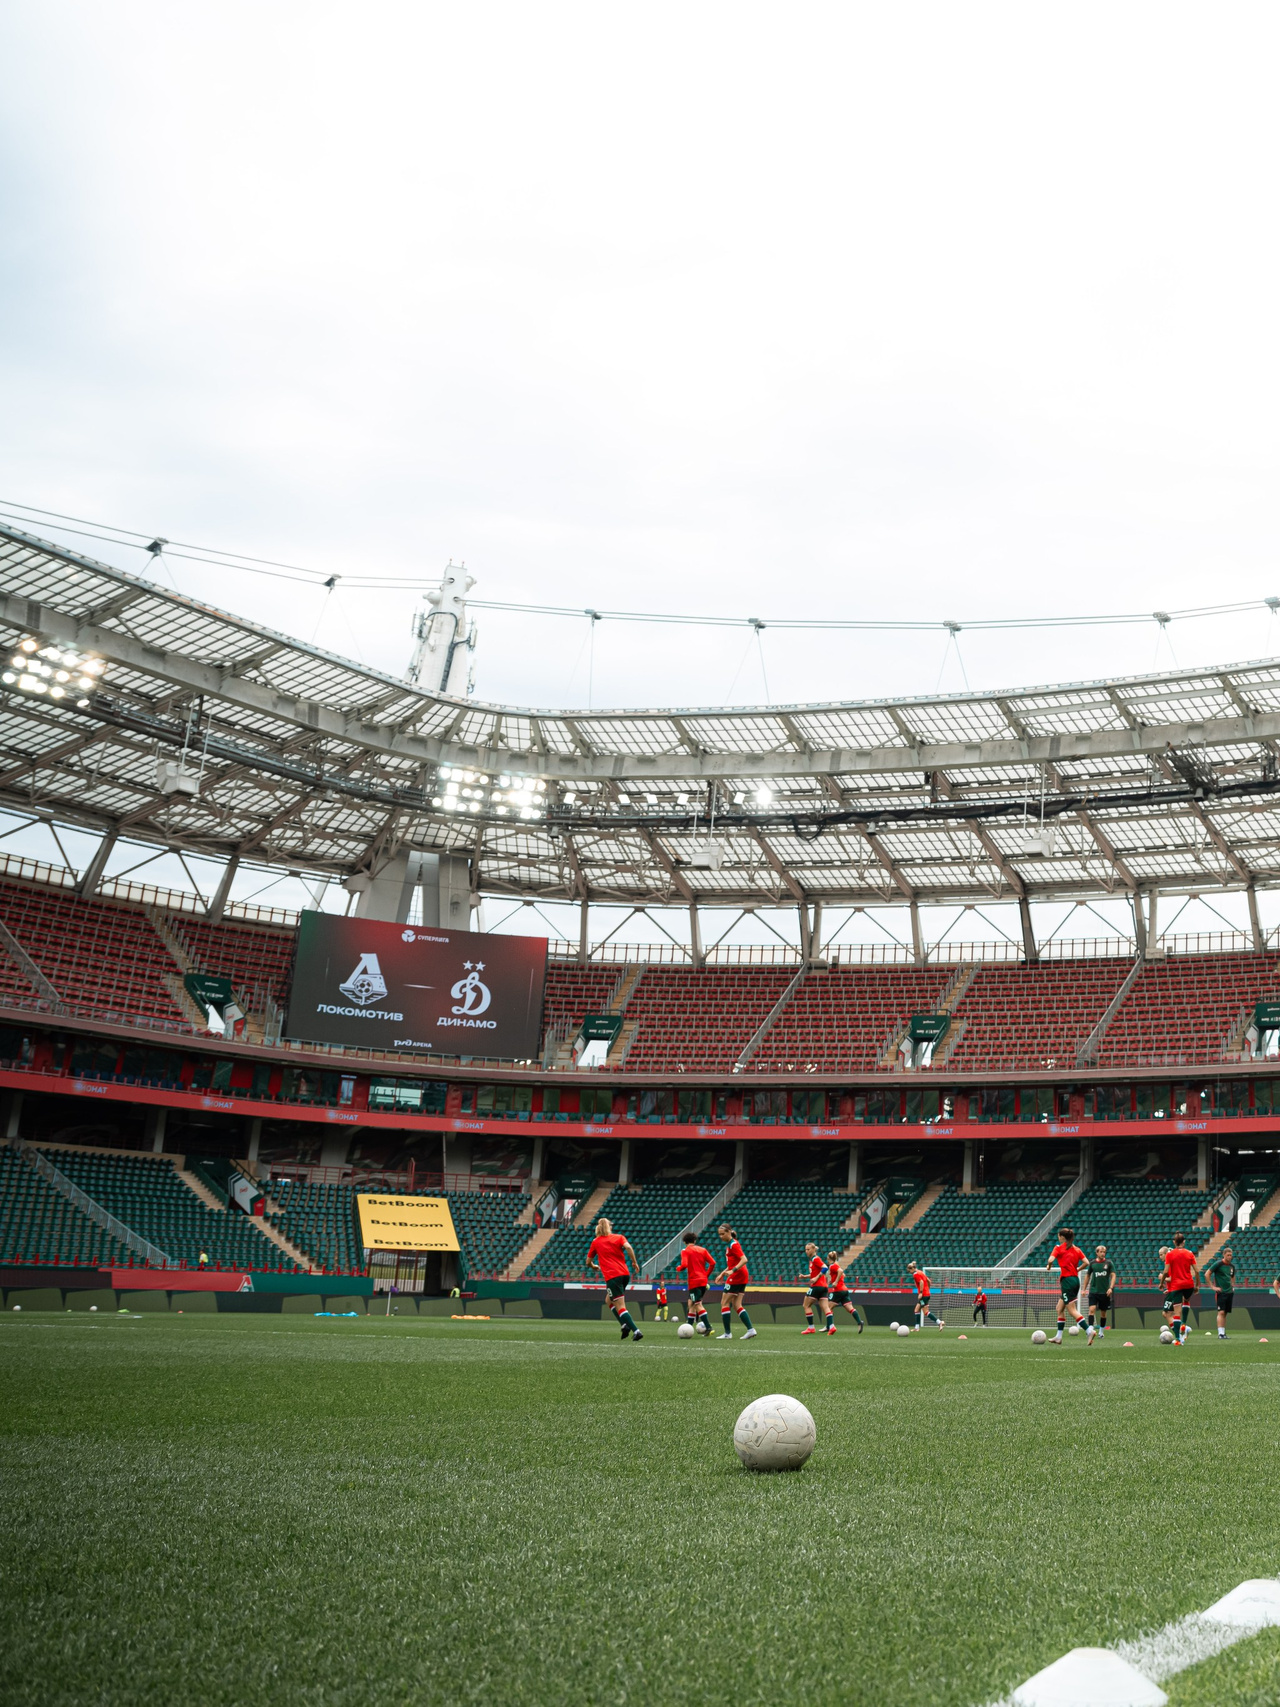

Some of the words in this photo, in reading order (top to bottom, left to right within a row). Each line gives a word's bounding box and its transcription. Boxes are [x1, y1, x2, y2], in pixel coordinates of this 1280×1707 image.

[316, 1003, 404, 1021] ЛОКОМОТИВ
[436, 1017, 497, 1029] ДИНАМО
[367, 1199, 439, 1208] BetBoom
[370, 1219, 444, 1228] BetBoom
[373, 1239, 449, 1248] BetBoom
